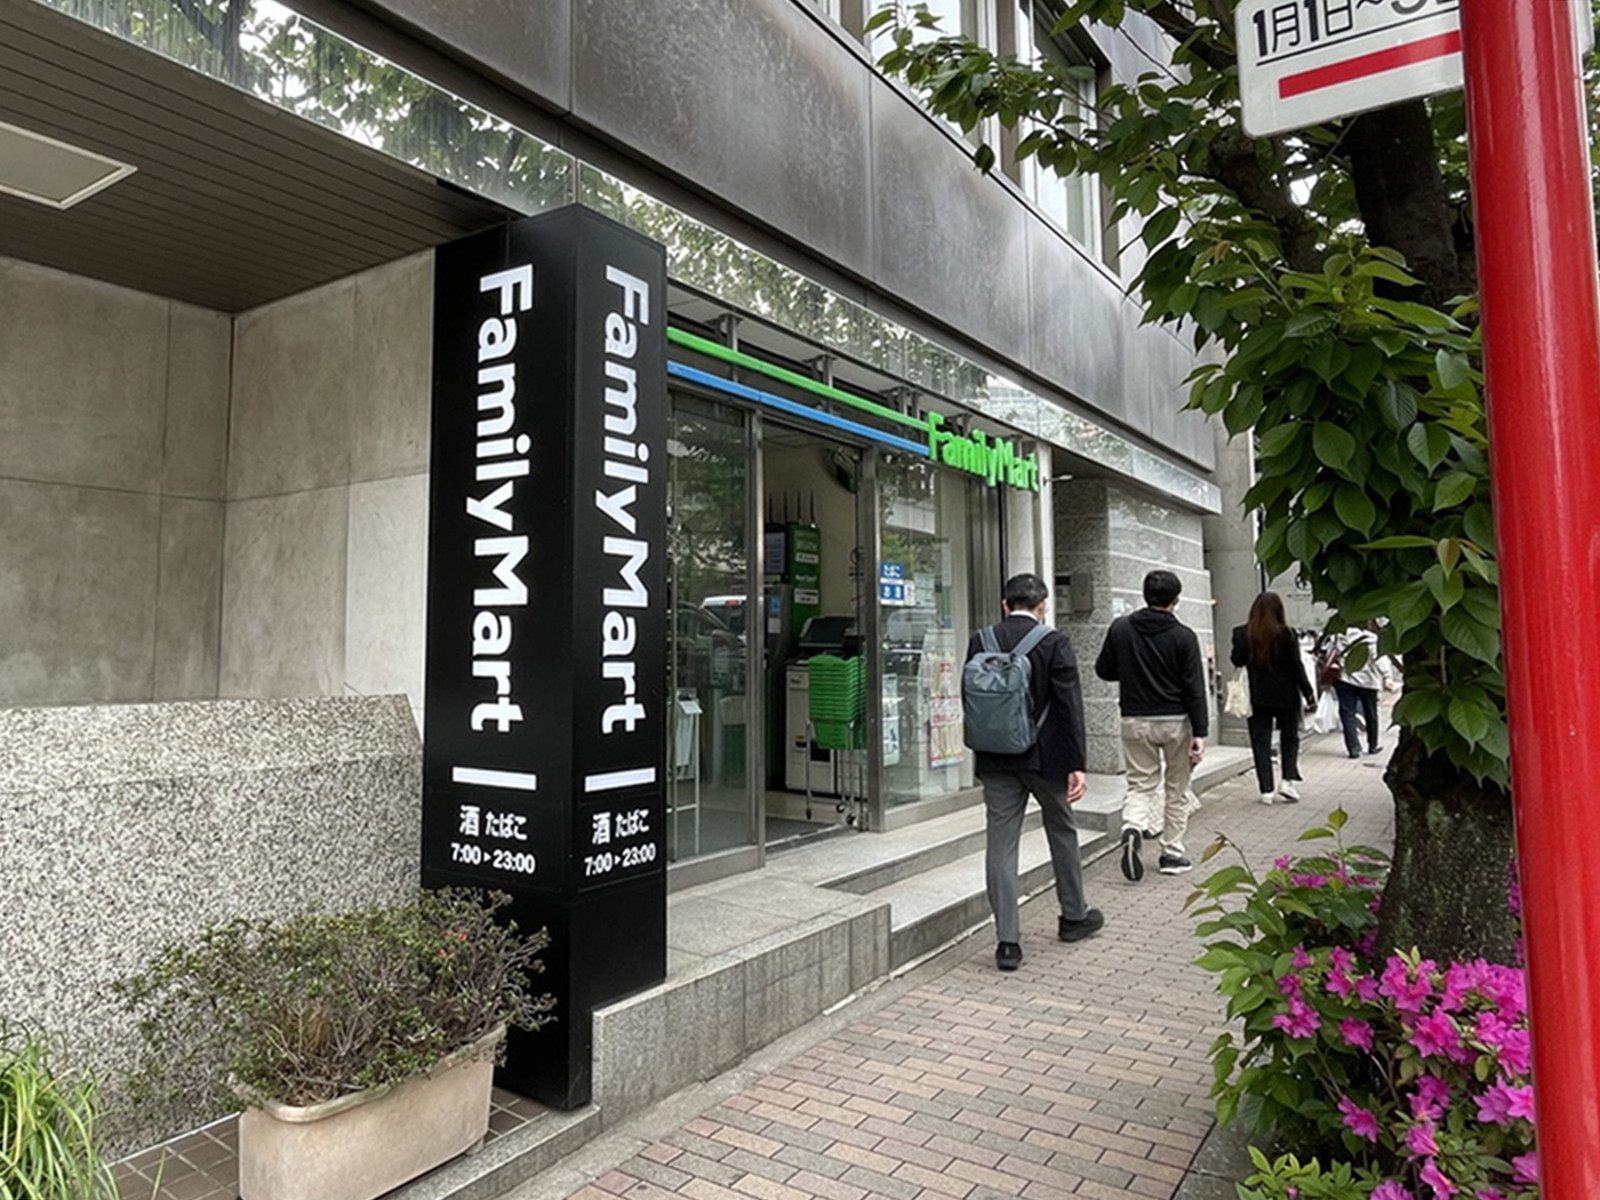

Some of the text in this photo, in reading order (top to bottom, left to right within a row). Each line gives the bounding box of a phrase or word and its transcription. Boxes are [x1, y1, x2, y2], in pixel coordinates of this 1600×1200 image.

[928, 411, 1039, 492] FamilyMart
[466, 263, 533, 733] FamilyMart
[595, 264, 649, 734] FamilyMart
[459, 804, 528, 841] 酒 たばこ
[592, 808, 650, 845] 酒 たばこ
[450, 842, 536, 875] 7:00 23:00
[584, 842, 657, 877] 7:00 23:00
